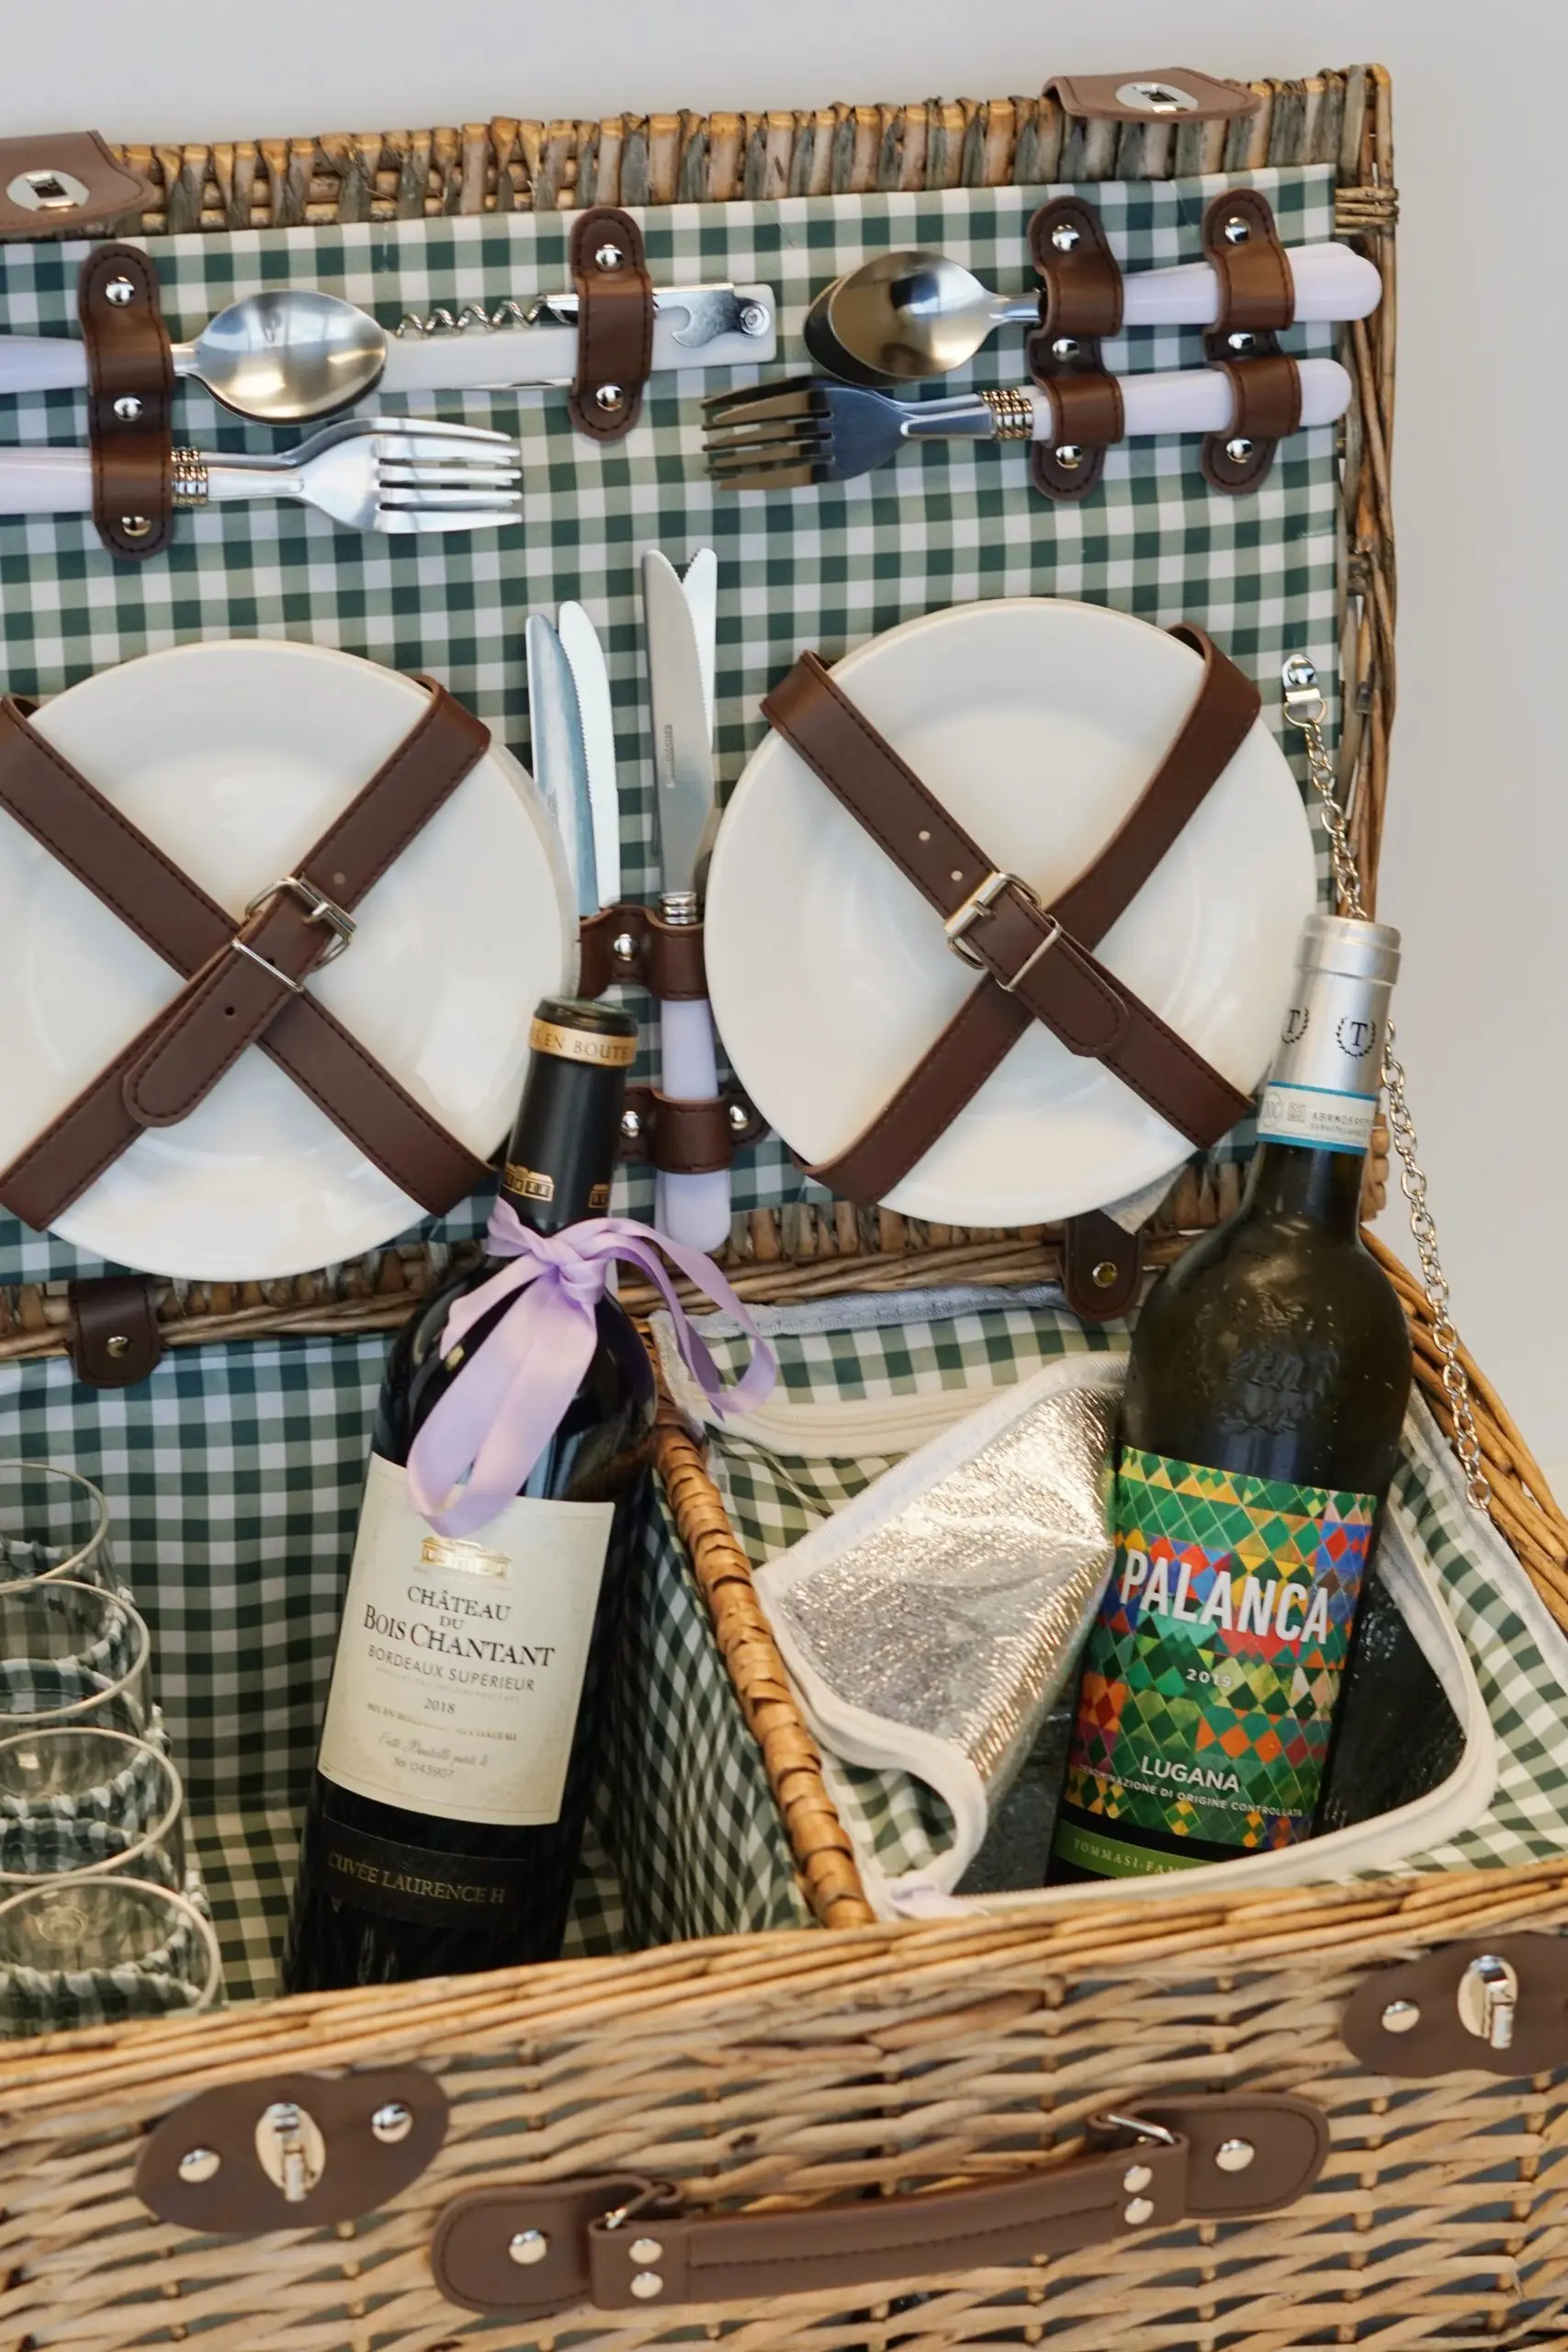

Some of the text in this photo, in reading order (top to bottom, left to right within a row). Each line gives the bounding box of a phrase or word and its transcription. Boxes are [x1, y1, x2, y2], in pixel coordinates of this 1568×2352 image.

[1351, 1021, 1368, 1046] T
[407, 1586, 513, 1621] CHÂTEAU
[1120, 1548, 1329, 1645] PALANCA
[363, 1603, 556, 1667] BOIS CHANTANT
[439, 1614, 464, 1630] DU
[367, 1644, 444, 1679] BORDEAUX
[1186, 1668, 1233, 1688] 2019
[423, 1697, 457, 1715] 2018
[1141, 1755, 1240, 1793] LUGANA
[1159, 1787, 1174, 1799] DI
[1176, 1791, 1228, 1810] ORIGINE
[381, 1871, 487, 1904] LAURENCE
